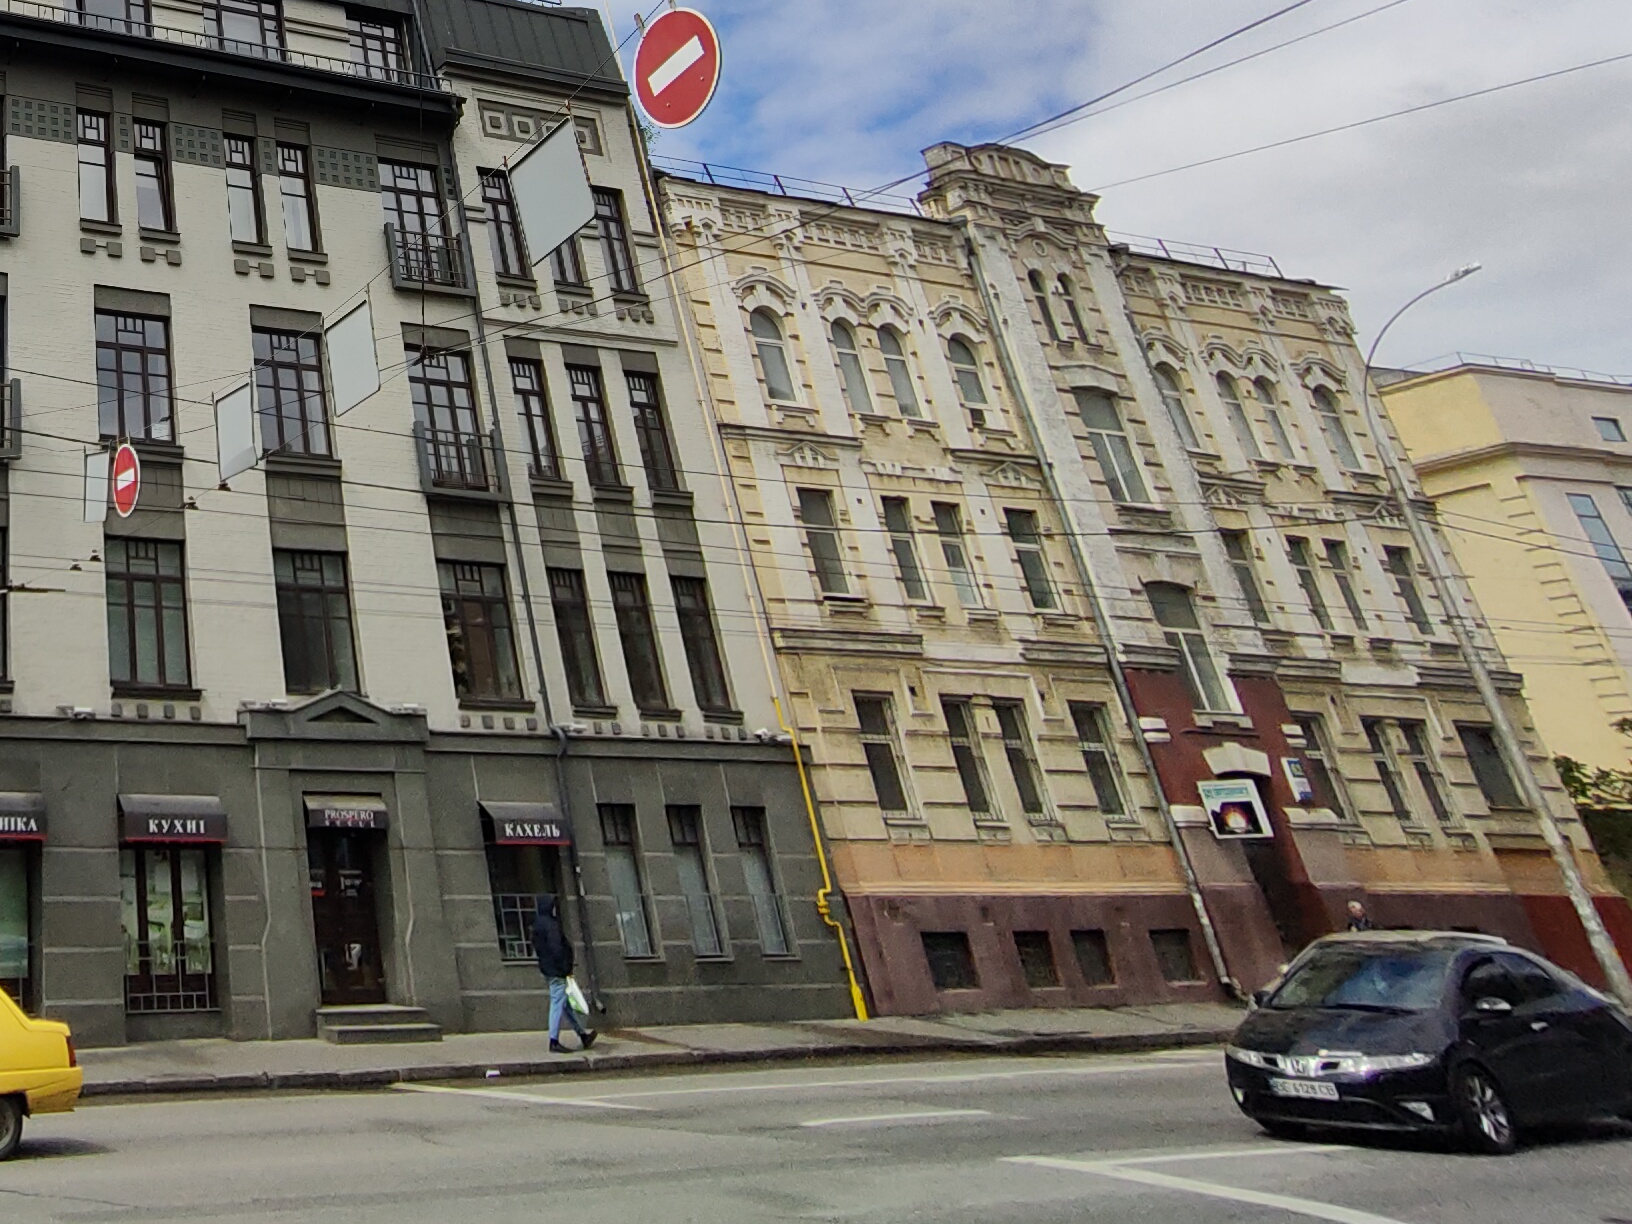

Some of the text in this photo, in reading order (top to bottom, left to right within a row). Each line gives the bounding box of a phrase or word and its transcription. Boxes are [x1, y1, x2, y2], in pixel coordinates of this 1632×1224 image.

[324, 809, 375, 821] PROSPERO
[148, 819, 206, 834] КУХНІ
[504, 822, 560, 838] КАХЕЛЬ
